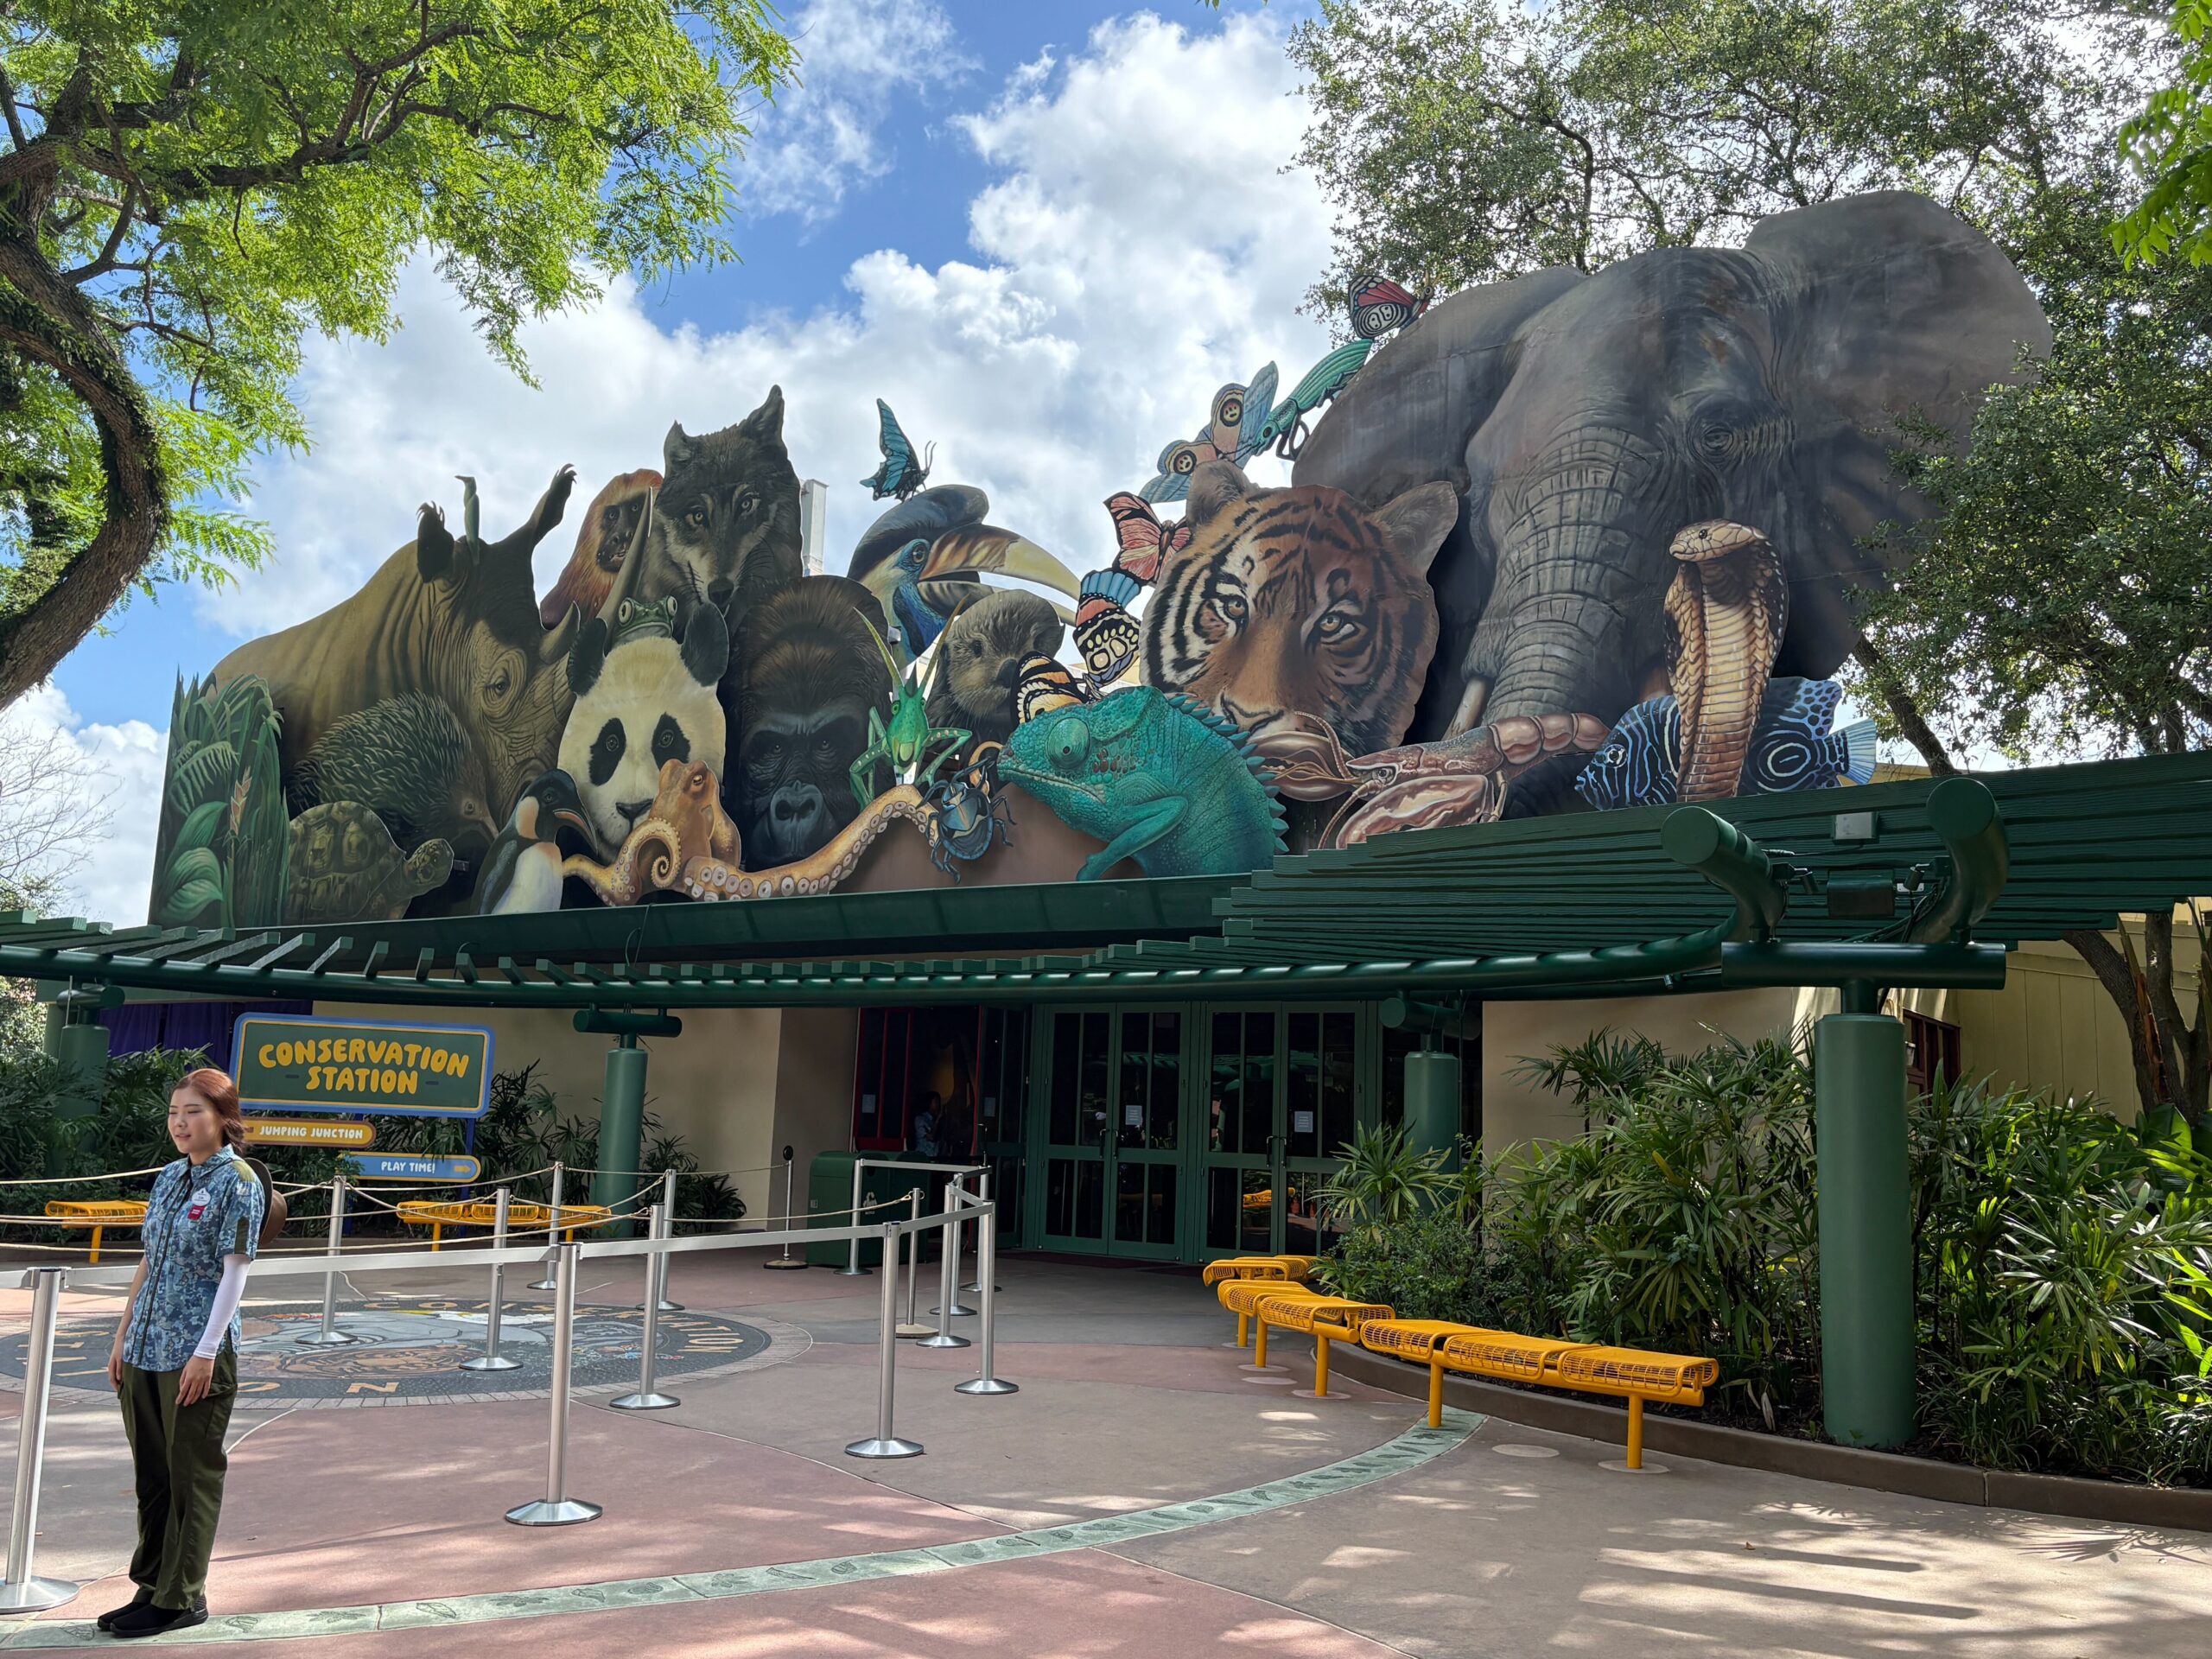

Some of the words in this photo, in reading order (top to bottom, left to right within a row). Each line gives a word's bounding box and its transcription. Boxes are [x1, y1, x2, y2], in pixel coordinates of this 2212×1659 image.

[258, 1039, 469, 1078] CONSERVATION
[306, 1065, 418, 1095] STATION
[259, 1126, 307, 1137] JUMPING
[310, 1128, 363, 1139] JUNCTION
[381, 1161, 406, 1172] PLAY
[409, 1162, 435, 1174] TIME!
